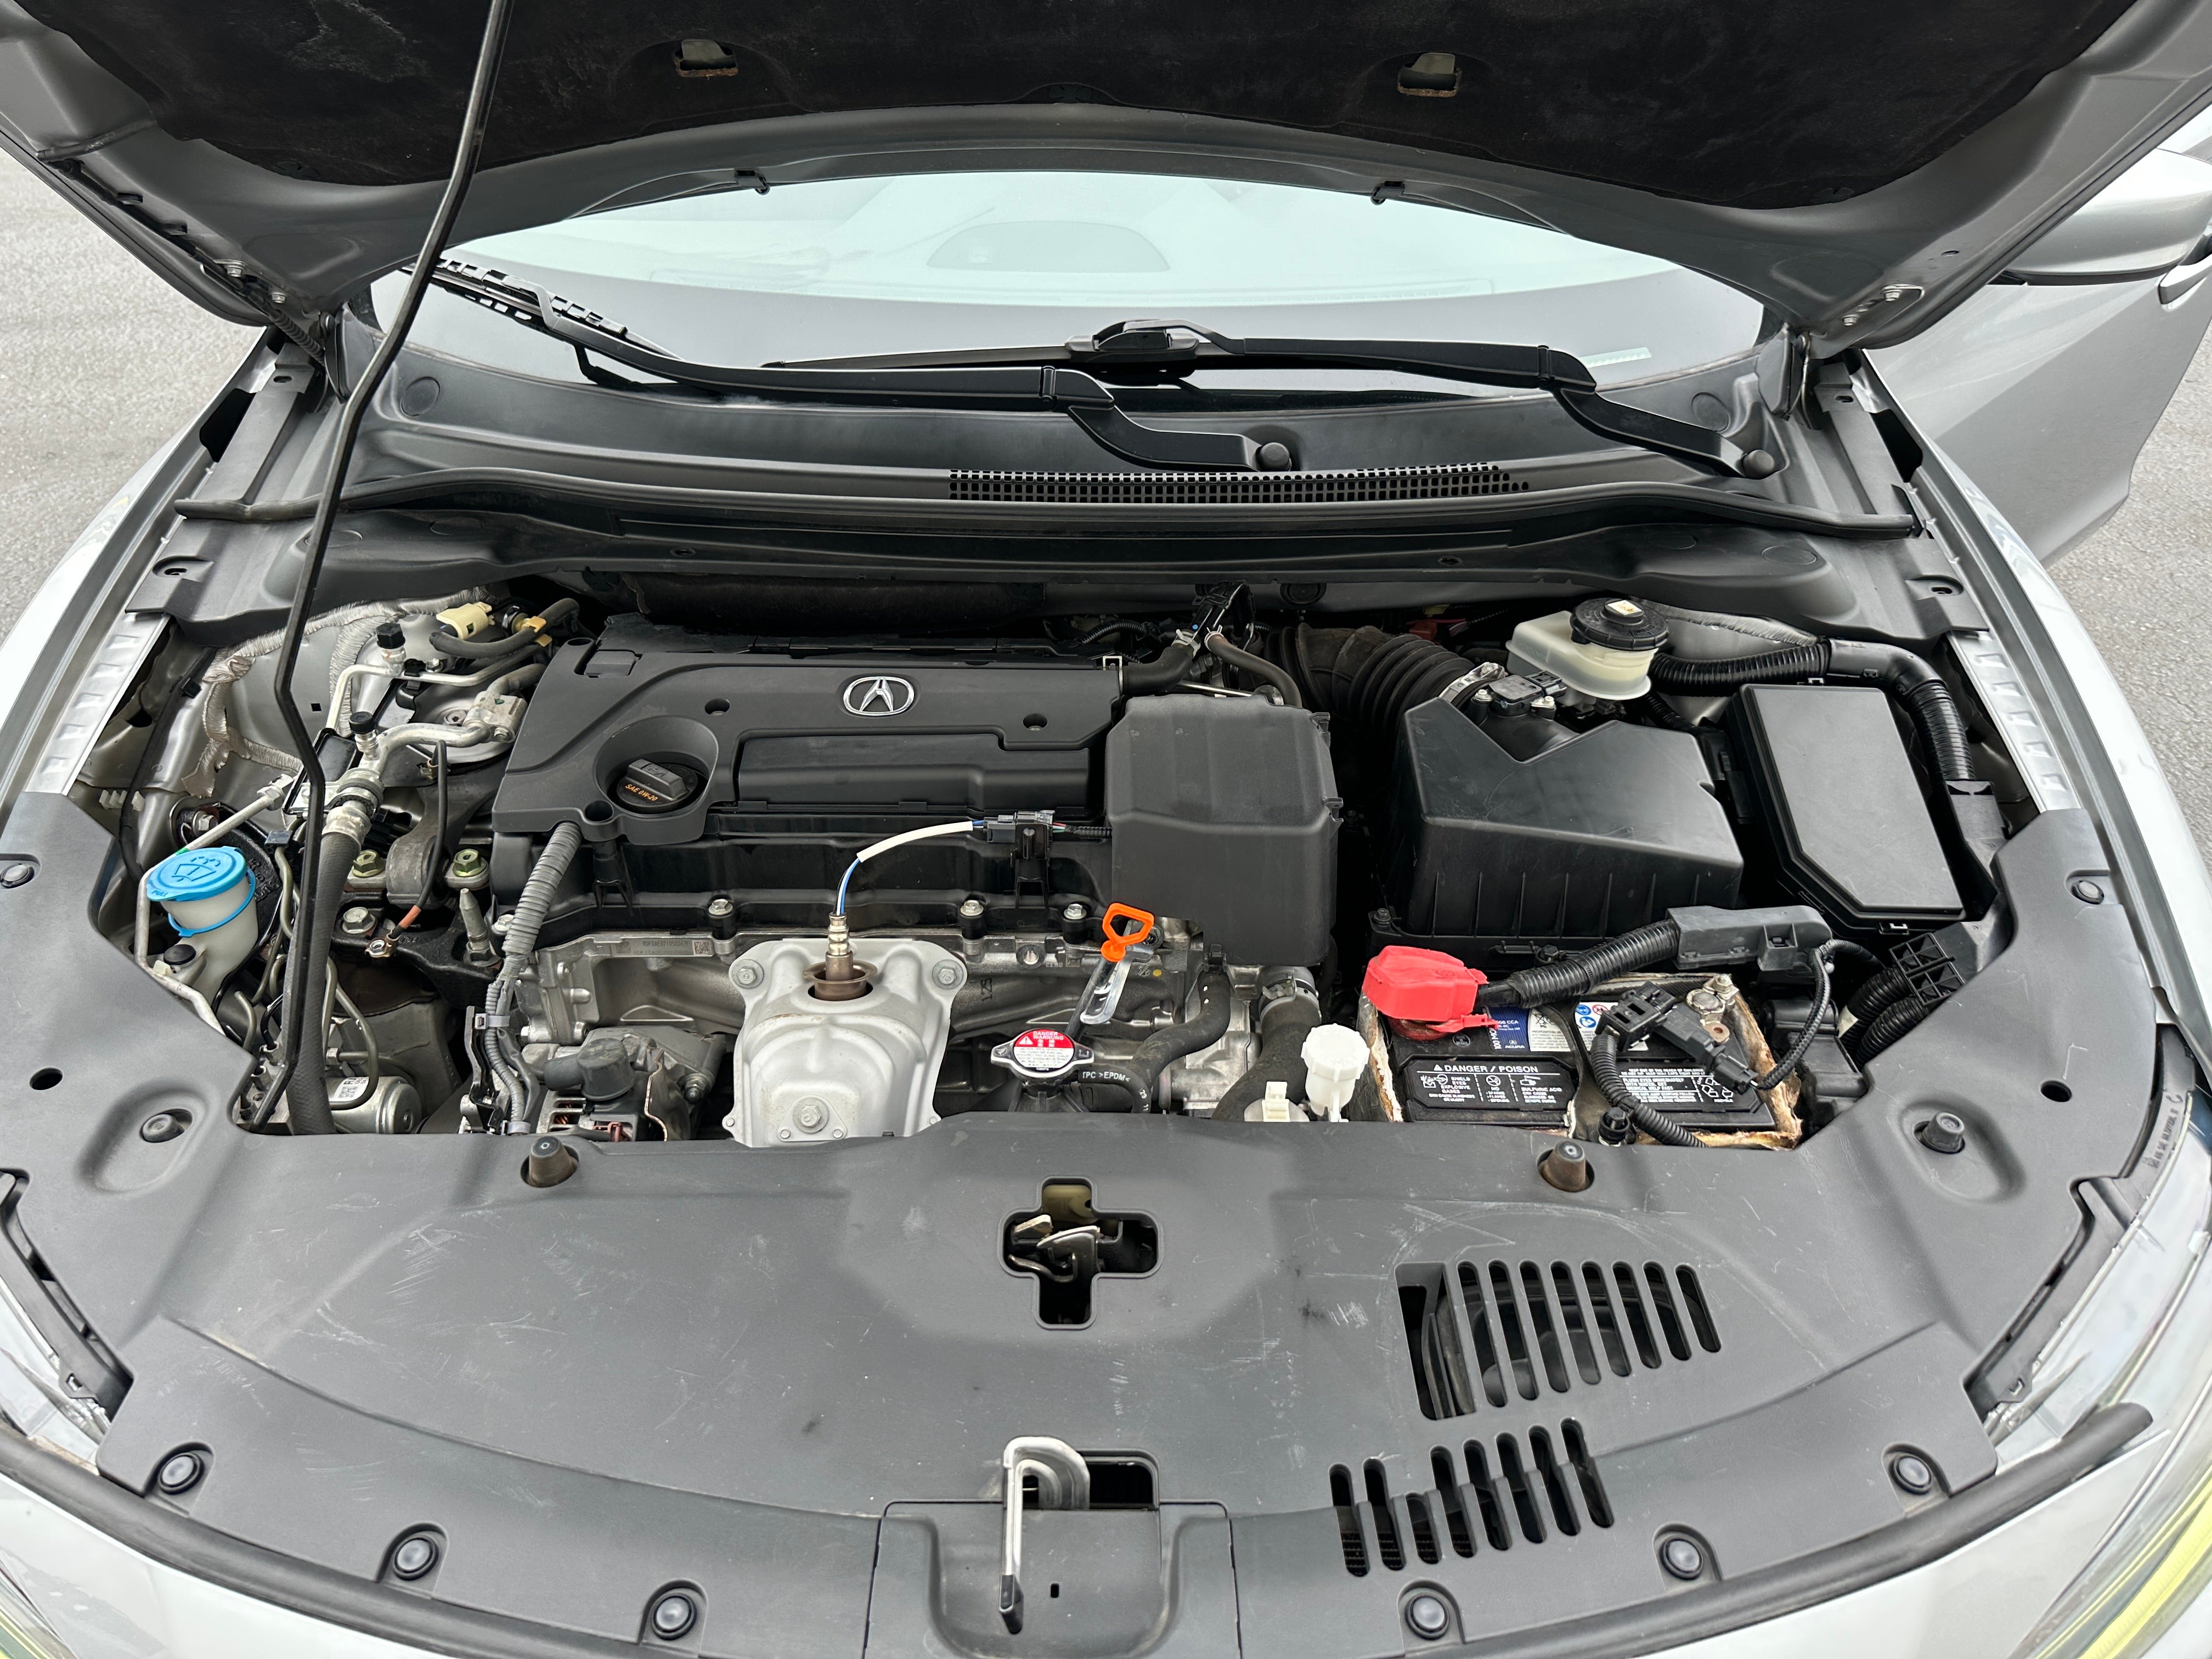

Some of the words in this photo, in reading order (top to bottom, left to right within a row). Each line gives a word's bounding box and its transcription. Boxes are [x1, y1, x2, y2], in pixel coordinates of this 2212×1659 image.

[625, 784, 640, 793] SAE
[638, 790, 658, 802] 0W-20
[1492, 1040, 1502, 1049] 100
[1444, 1064, 1488, 1073] DANGER
[1098, 1071, 1131, 1082] >EPDM<
